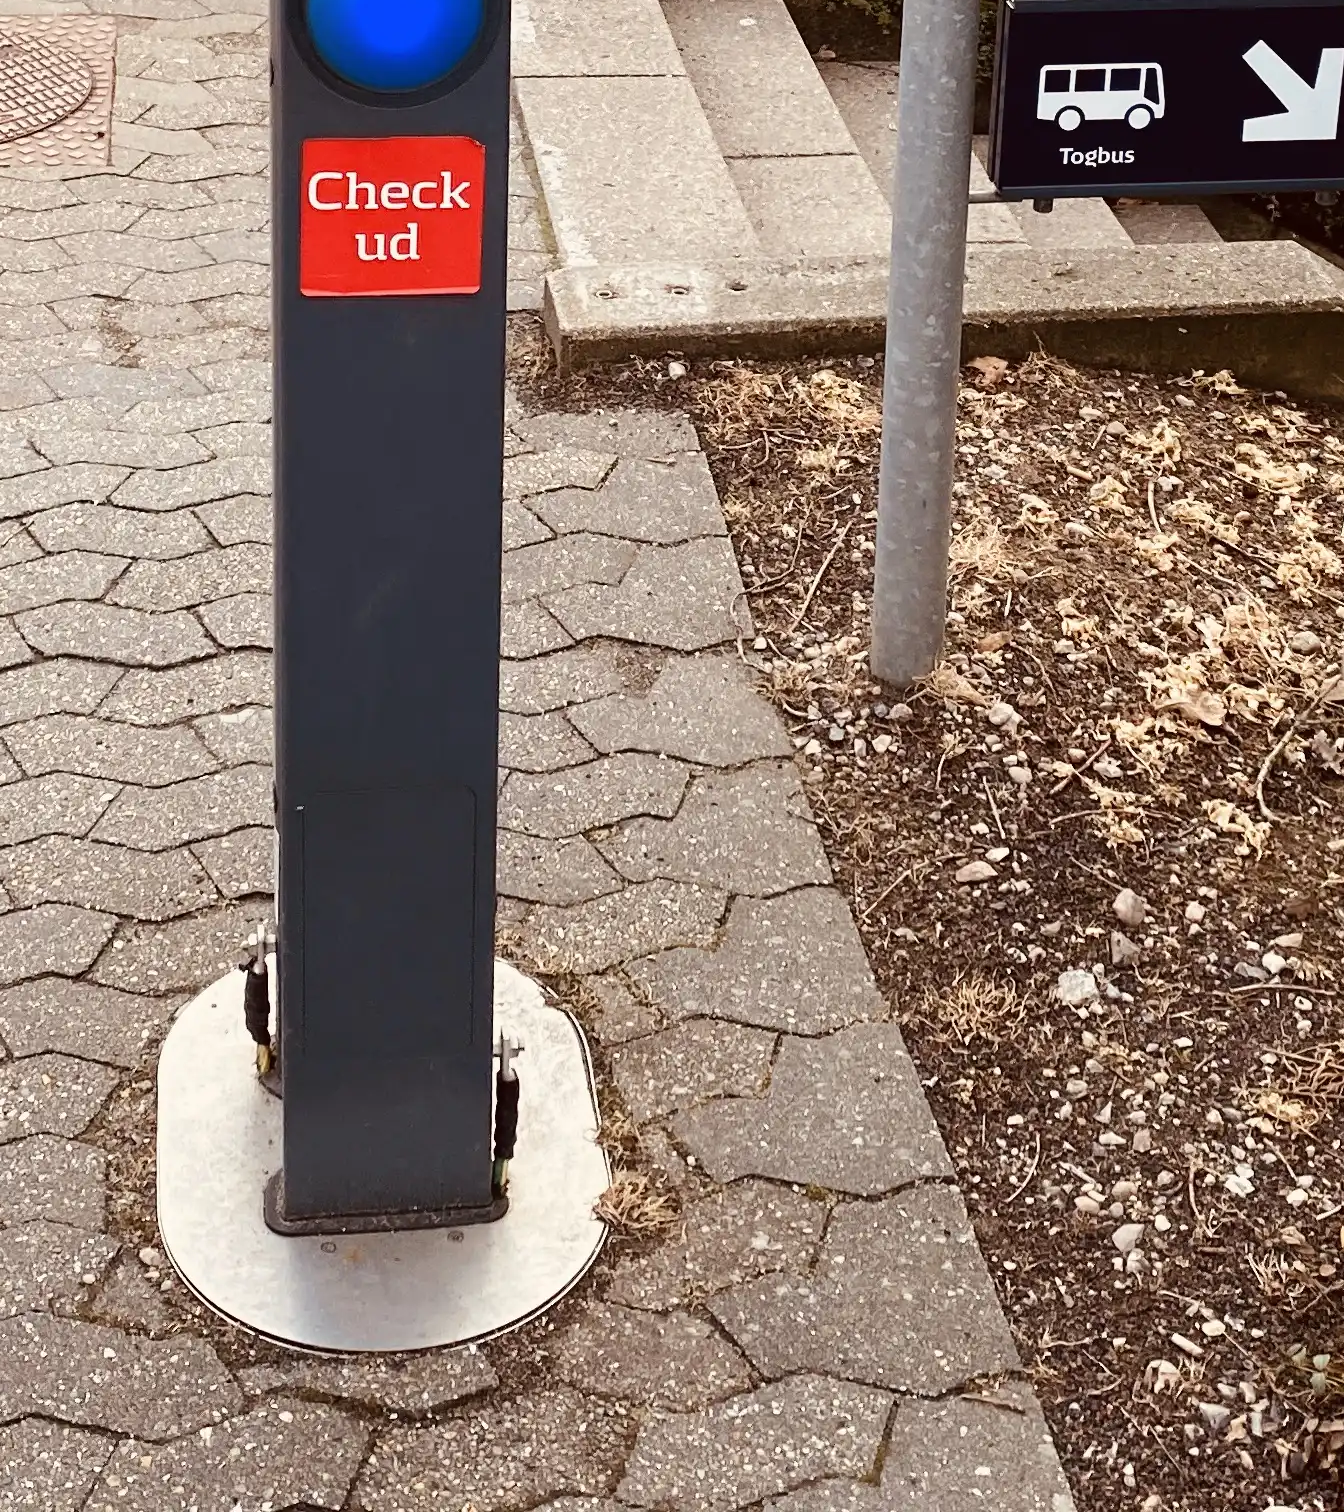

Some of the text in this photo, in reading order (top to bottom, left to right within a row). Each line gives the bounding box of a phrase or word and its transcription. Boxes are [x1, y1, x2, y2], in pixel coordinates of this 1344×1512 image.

[1059, 146, 1135, 168] Togbus
[308, 171, 471, 211] Check
[354, 222, 421, 262] ud
